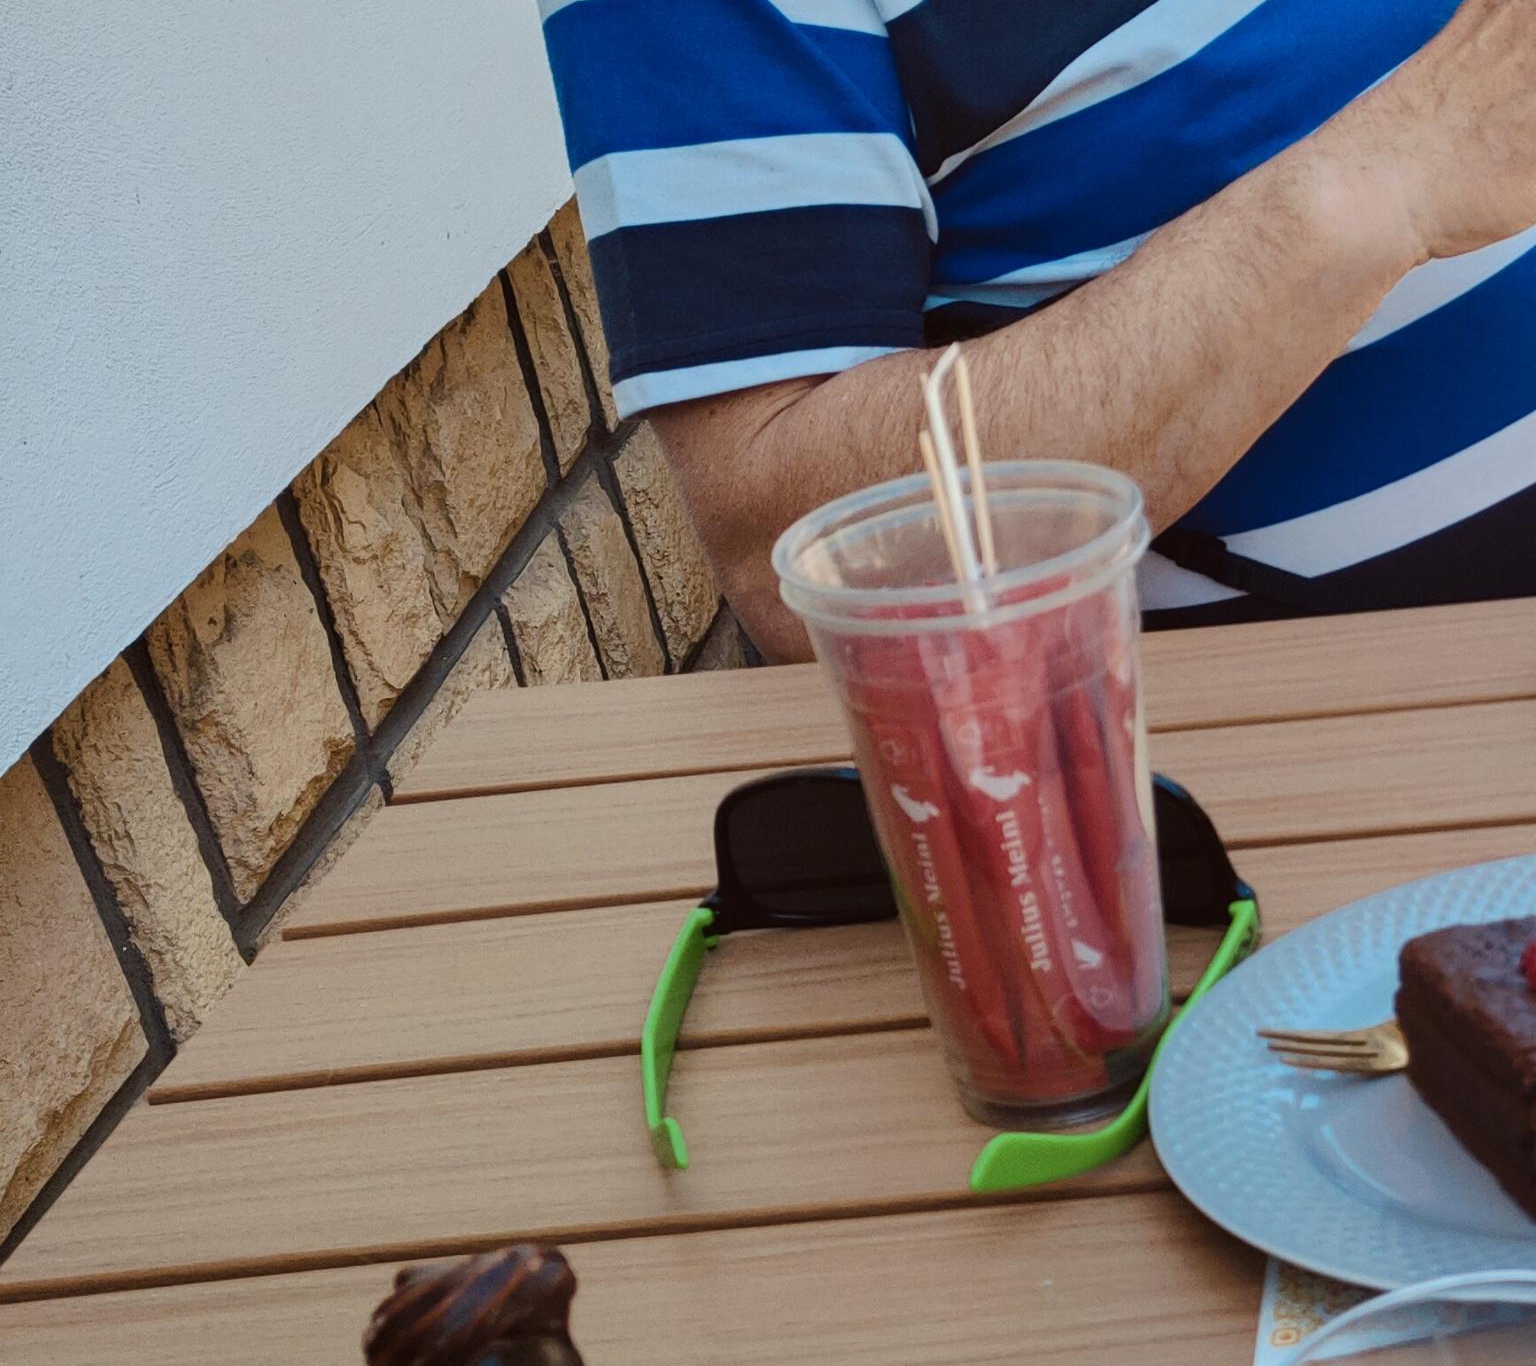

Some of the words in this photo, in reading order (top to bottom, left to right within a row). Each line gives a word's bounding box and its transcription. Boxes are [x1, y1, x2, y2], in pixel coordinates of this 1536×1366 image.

[911, 832, 940, 903] Meinl
[995, 809, 1031, 886] Meinl
[936, 911, 967, 990] Julius
[1018, 891, 1052, 972] Julius
